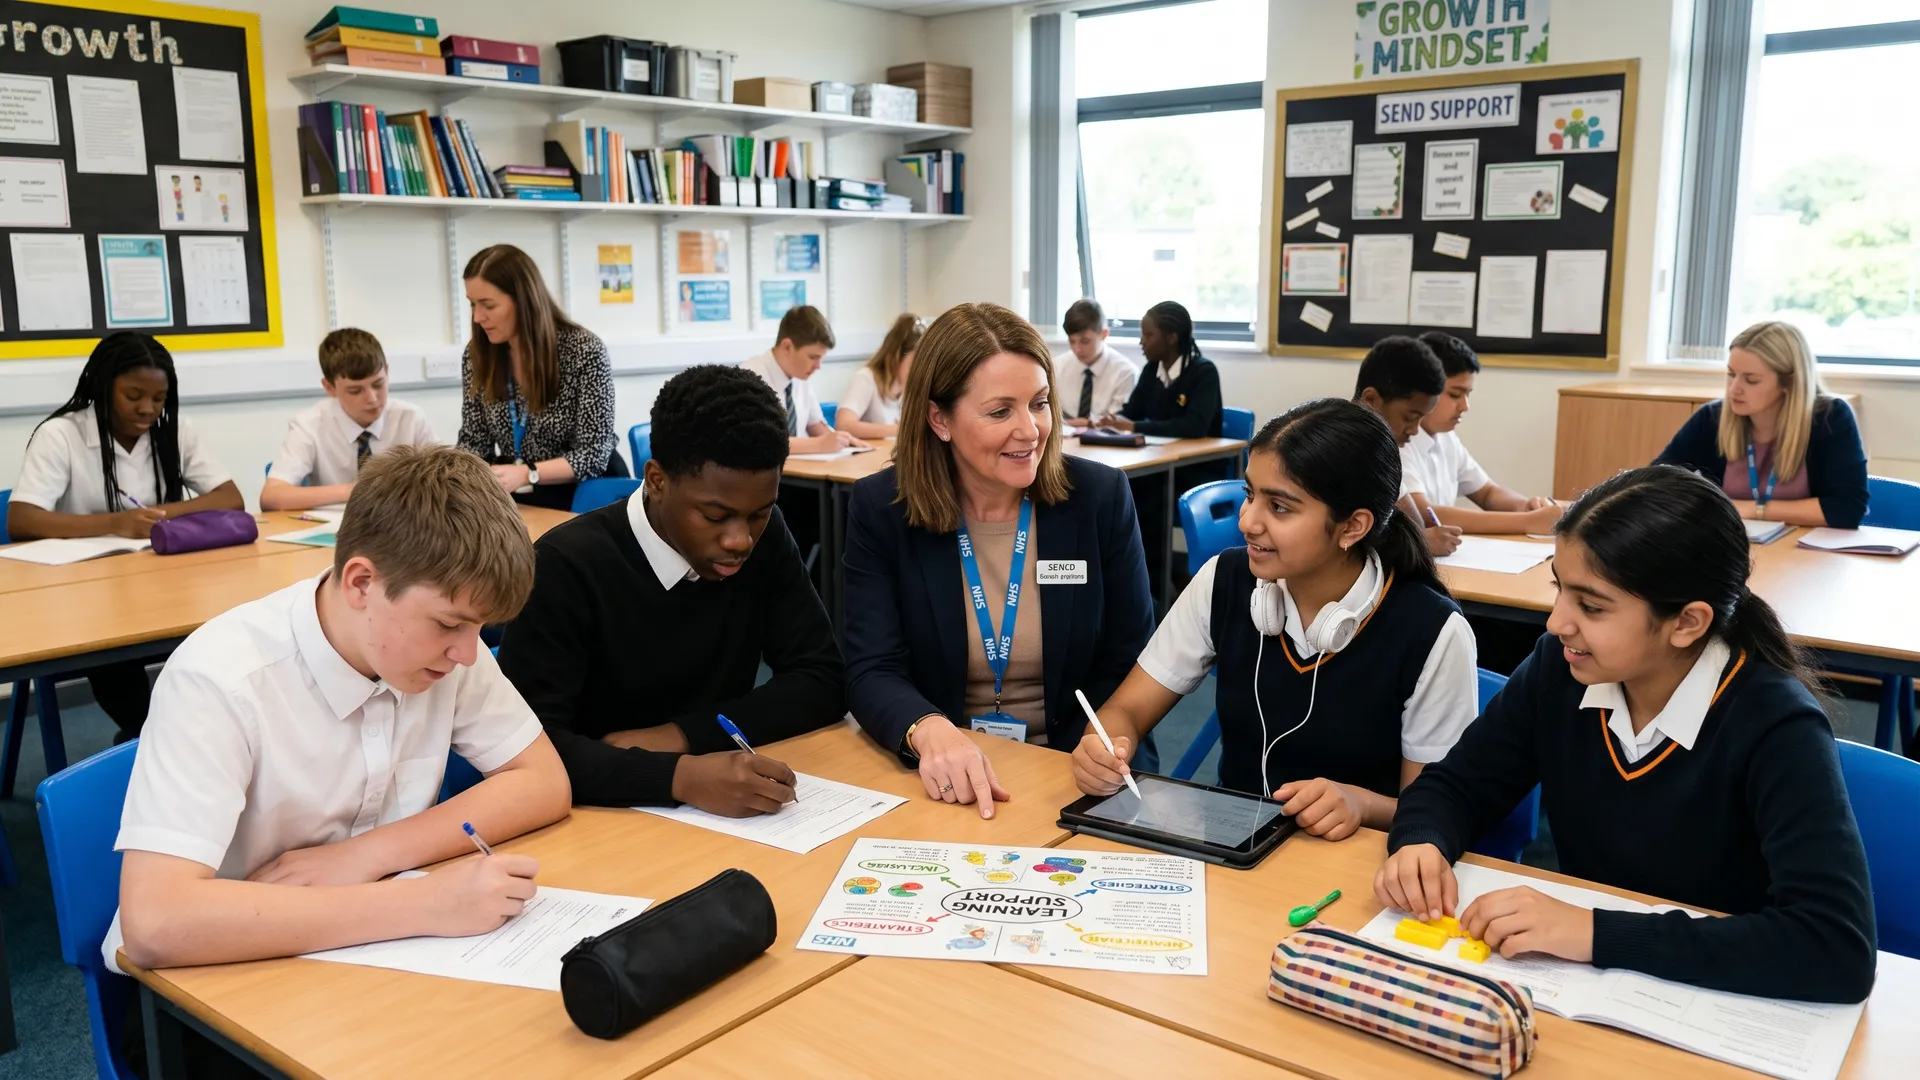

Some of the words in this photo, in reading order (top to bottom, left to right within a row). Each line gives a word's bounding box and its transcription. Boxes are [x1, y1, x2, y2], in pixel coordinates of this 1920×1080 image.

[1379, 0, 1526, 36] GROWTH
[1372, 25, 1529, 75] MINDSET
[1381, 102, 1425, 124] SEND
[1430, 95, 1514, 120] SUPPORT
[958, 534, 973, 557] NHS
[1015, 530, 1027, 554] NHS
[971, 585, 986, 609] NHS
[1007, 582, 1019, 607] NHS
[984, 638, 997, 661] NHS
[999, 635, 1011, 660] NHS
[952, 902, 1068, 917] LEARNING
[961, 892, 1067, 906] SUPPORT
[814, 935, 854, 946] NHS
